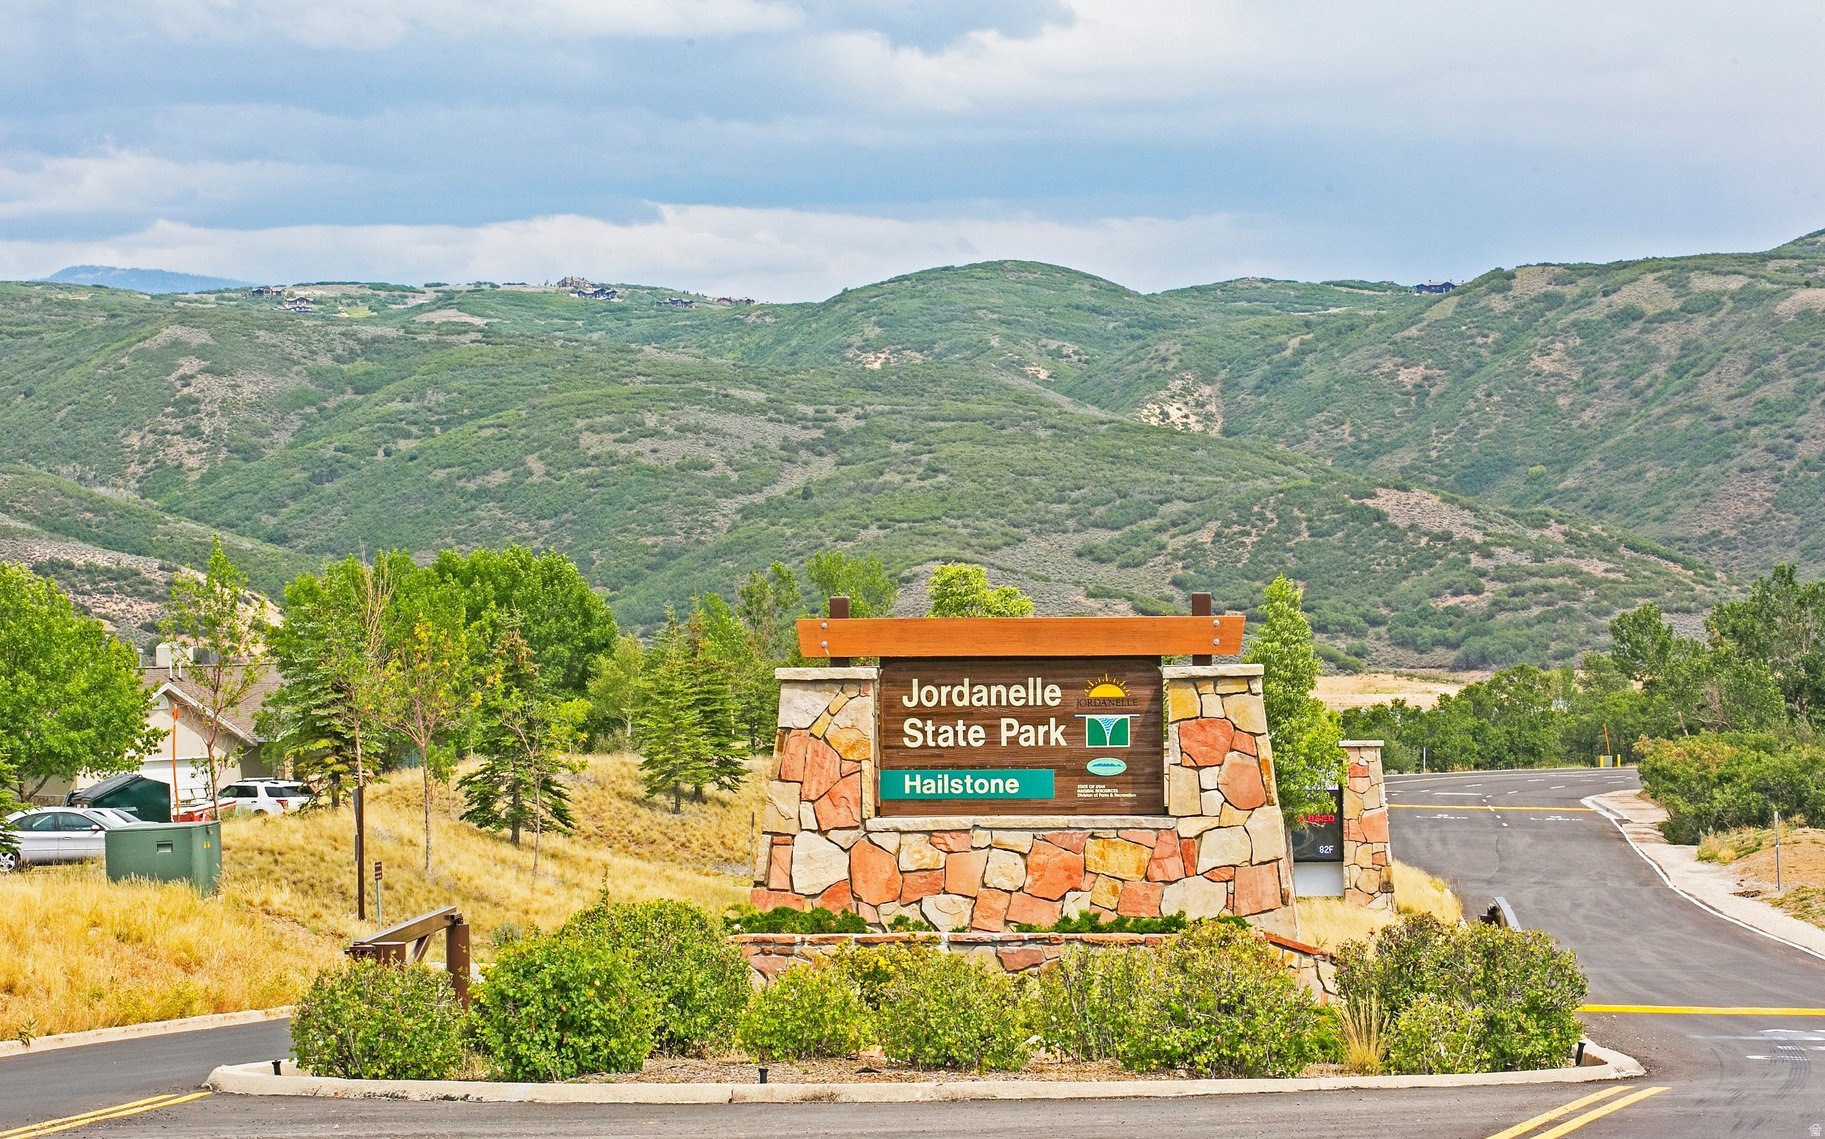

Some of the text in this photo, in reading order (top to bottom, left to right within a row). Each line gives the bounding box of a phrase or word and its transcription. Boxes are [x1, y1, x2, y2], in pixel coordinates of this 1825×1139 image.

[902, 677, 1062, 708] Jordanelle
[1076, 698, 1138, 709] JORDANELLE
[902, 717, 1067, 748] State Park
[904, 774, 1020, 795] Hailstone
[1319, 846, 1334, 854] 82F
